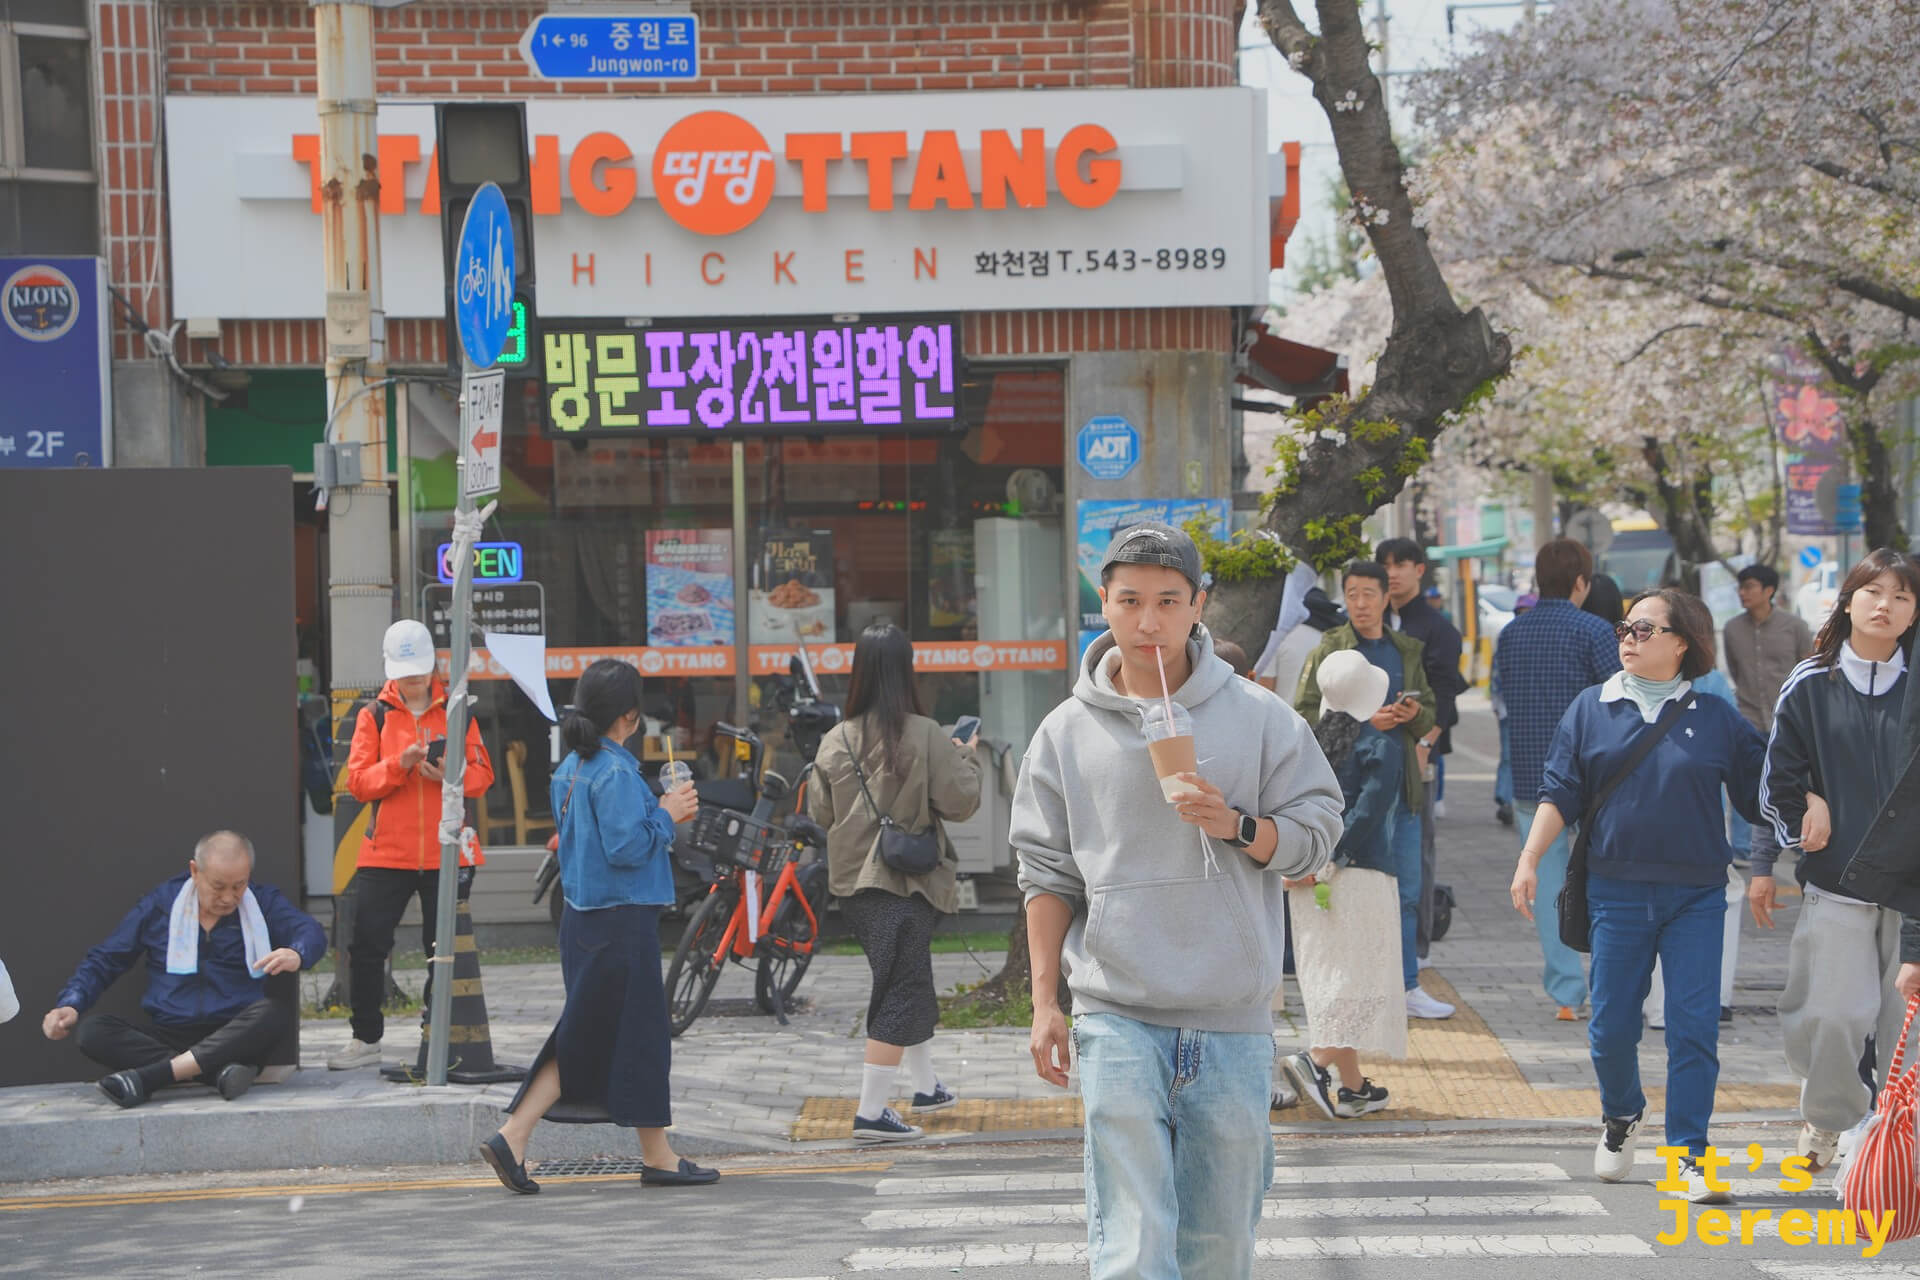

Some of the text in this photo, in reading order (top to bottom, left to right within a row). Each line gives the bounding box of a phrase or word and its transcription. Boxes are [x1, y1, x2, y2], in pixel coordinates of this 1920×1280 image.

[541, 34, 589, 49] 1 96
[609, 22, 689, 51] 중원로
[588, 56, 689, 76] Jungwon-ro
[292, 131, 637, 217] TTG
[785, 123, 1122, 213] TTANG
[572, 246, 938, 287] HICKEN
[975, 247, 1227, 277] 화천점 T.543-8989
[26, 430, 64, 458] 2F
[1087, 436, 1131, 460] ADT
[471, 463, 496, 489] 300m
[663, 651, 727, 670] TTANG
[997, 643, 1058, 663] TTANG
